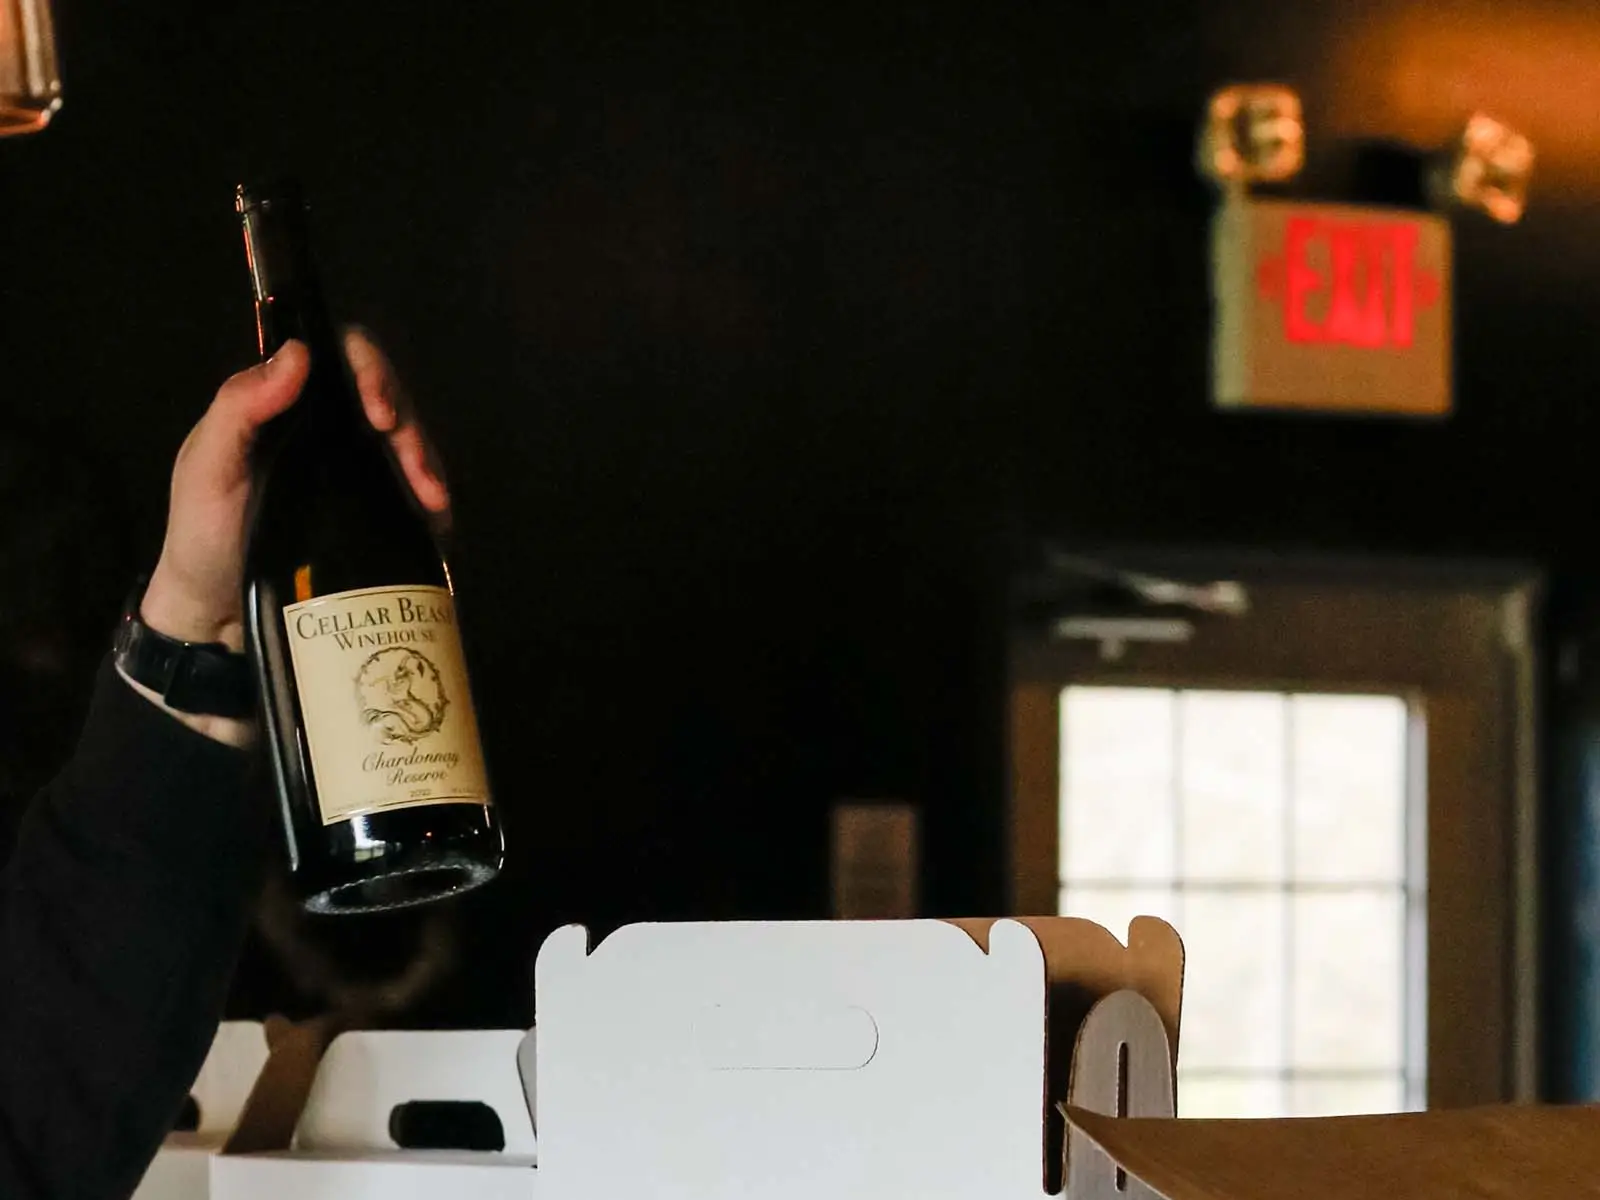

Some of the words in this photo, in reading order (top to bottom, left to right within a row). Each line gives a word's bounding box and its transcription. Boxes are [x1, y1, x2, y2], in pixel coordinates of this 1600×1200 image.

[1284, 214, 1419, 348] EXIT
[296, 606, 392, 641] CELLAR
[334, 628, 437, 651] WINEHOUSE
[362, 746, 460, 772] Chardonnay
[387, 766, 449, 786] Reserve
